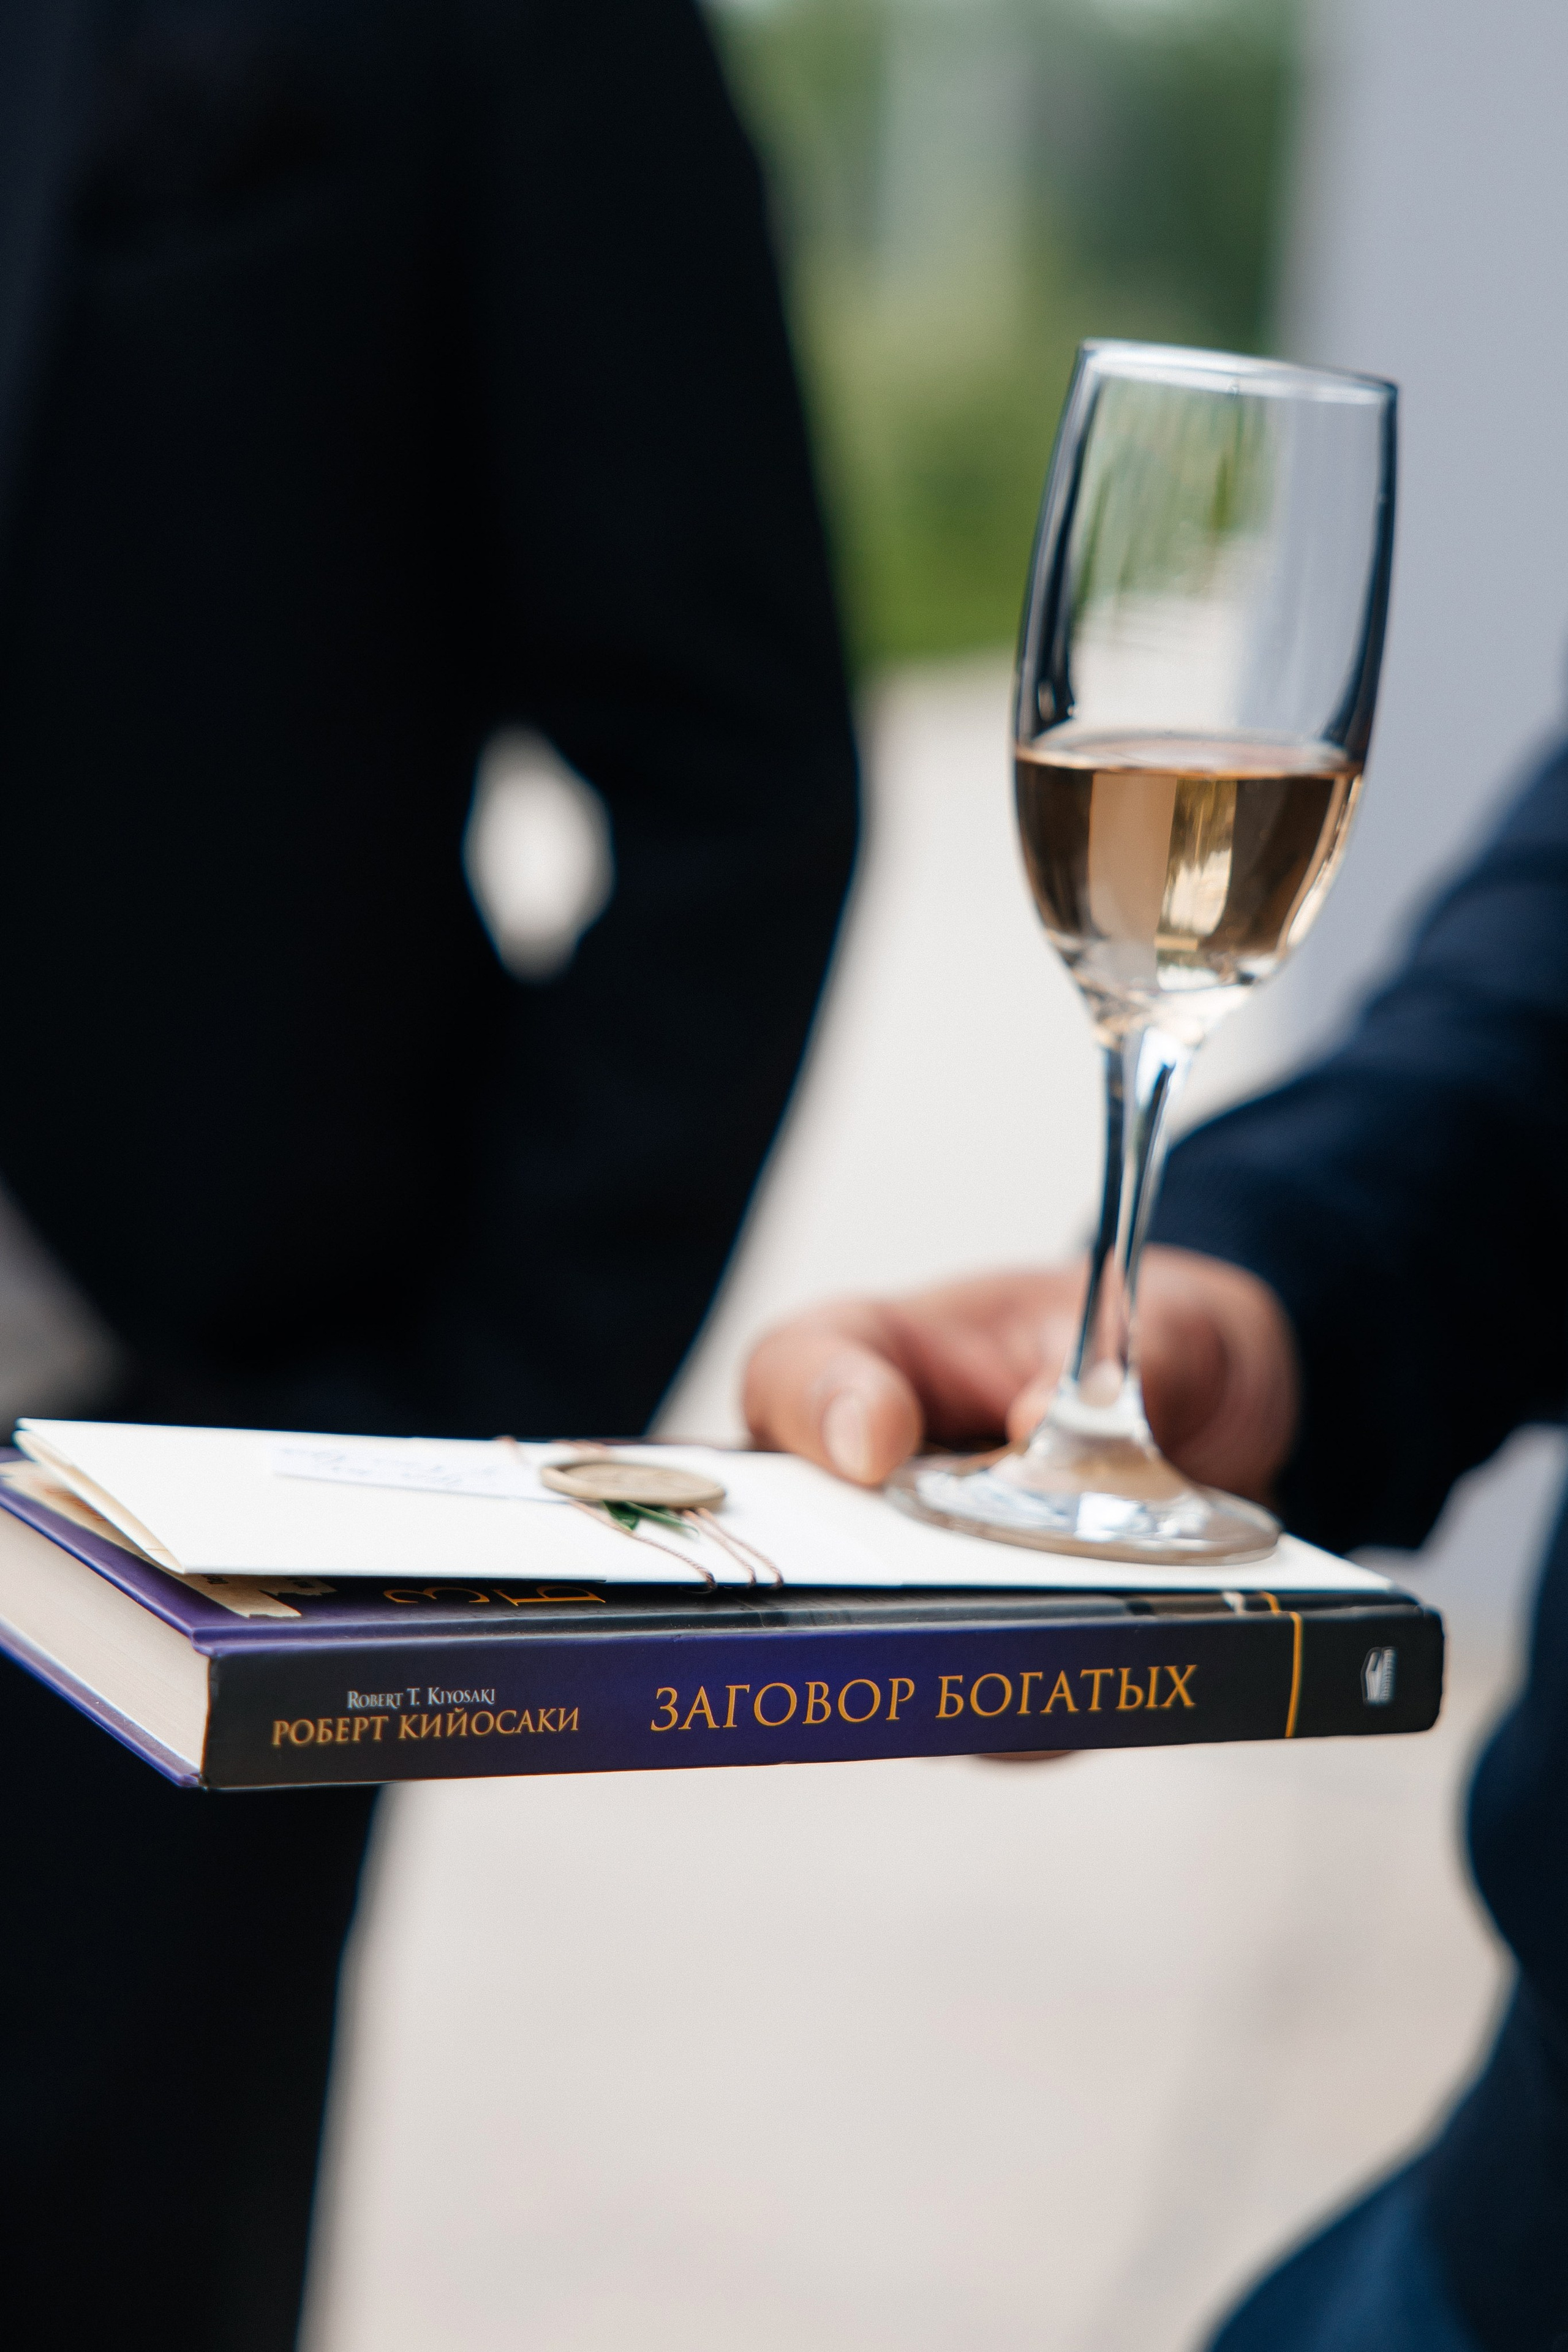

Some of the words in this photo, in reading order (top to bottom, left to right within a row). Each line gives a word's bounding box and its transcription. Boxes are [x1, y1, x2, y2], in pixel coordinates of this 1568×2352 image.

[407, 1688, 420, 1706] T.
[650, 1677, 915, 1732] ЗАГОВОР
[936, 1664, 1197, 1719] БОГАТЫХ
[272, 1715, 389, 1746] РОБЕРТ
[398, 1708, 579, 1740] КИЙОСАКИ
